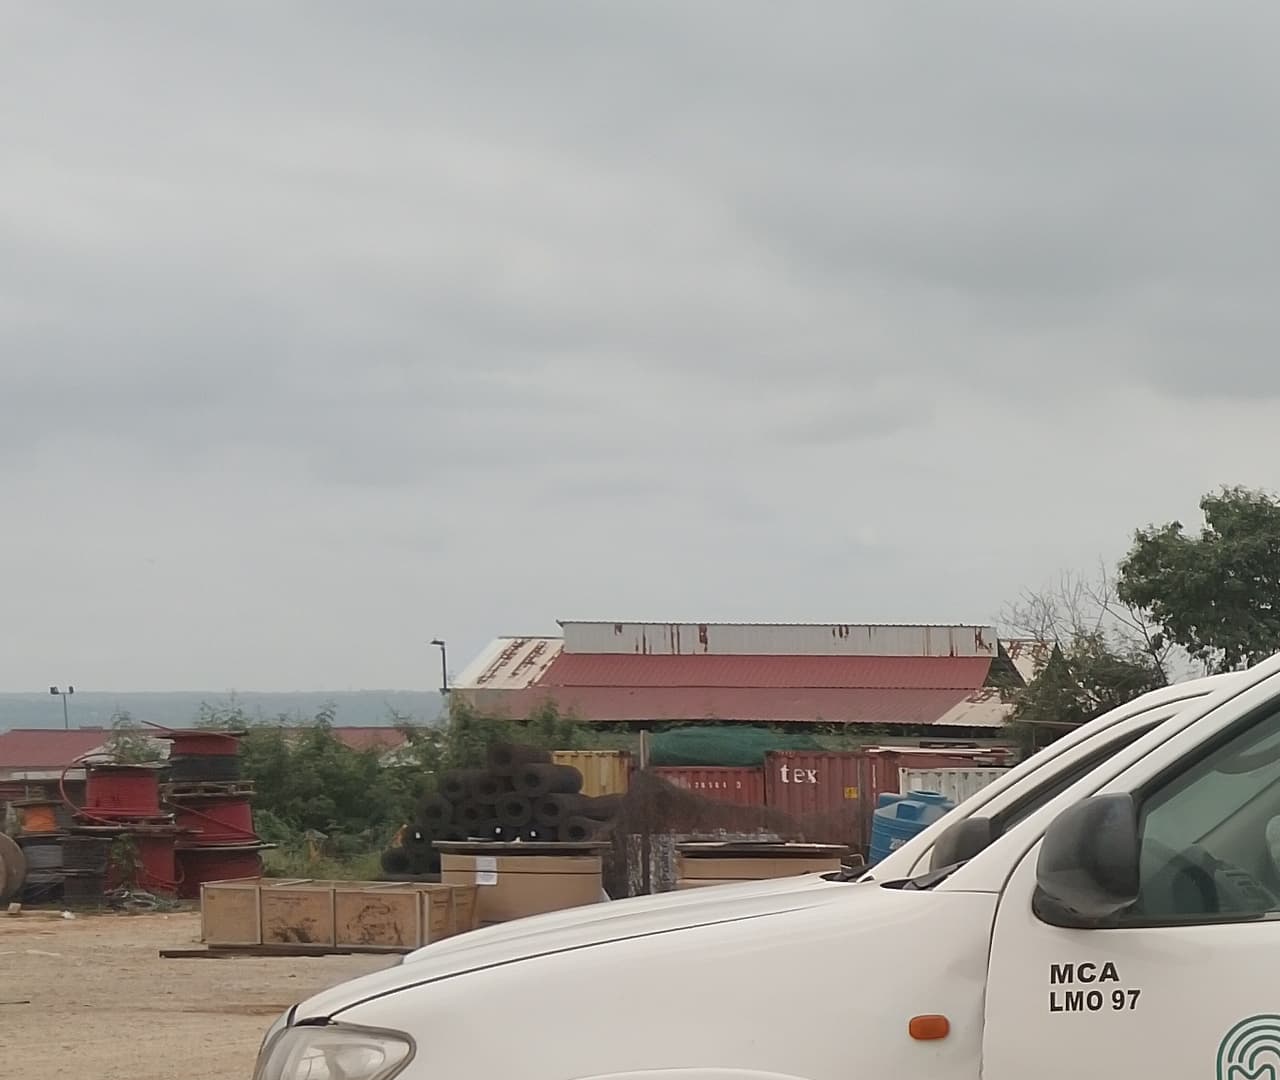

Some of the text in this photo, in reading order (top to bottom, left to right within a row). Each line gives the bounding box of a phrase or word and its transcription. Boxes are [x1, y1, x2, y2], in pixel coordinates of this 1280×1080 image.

[1050, 961, 1120, 985] MCA
[1049, 989, 1142, 1013] LMO 97
